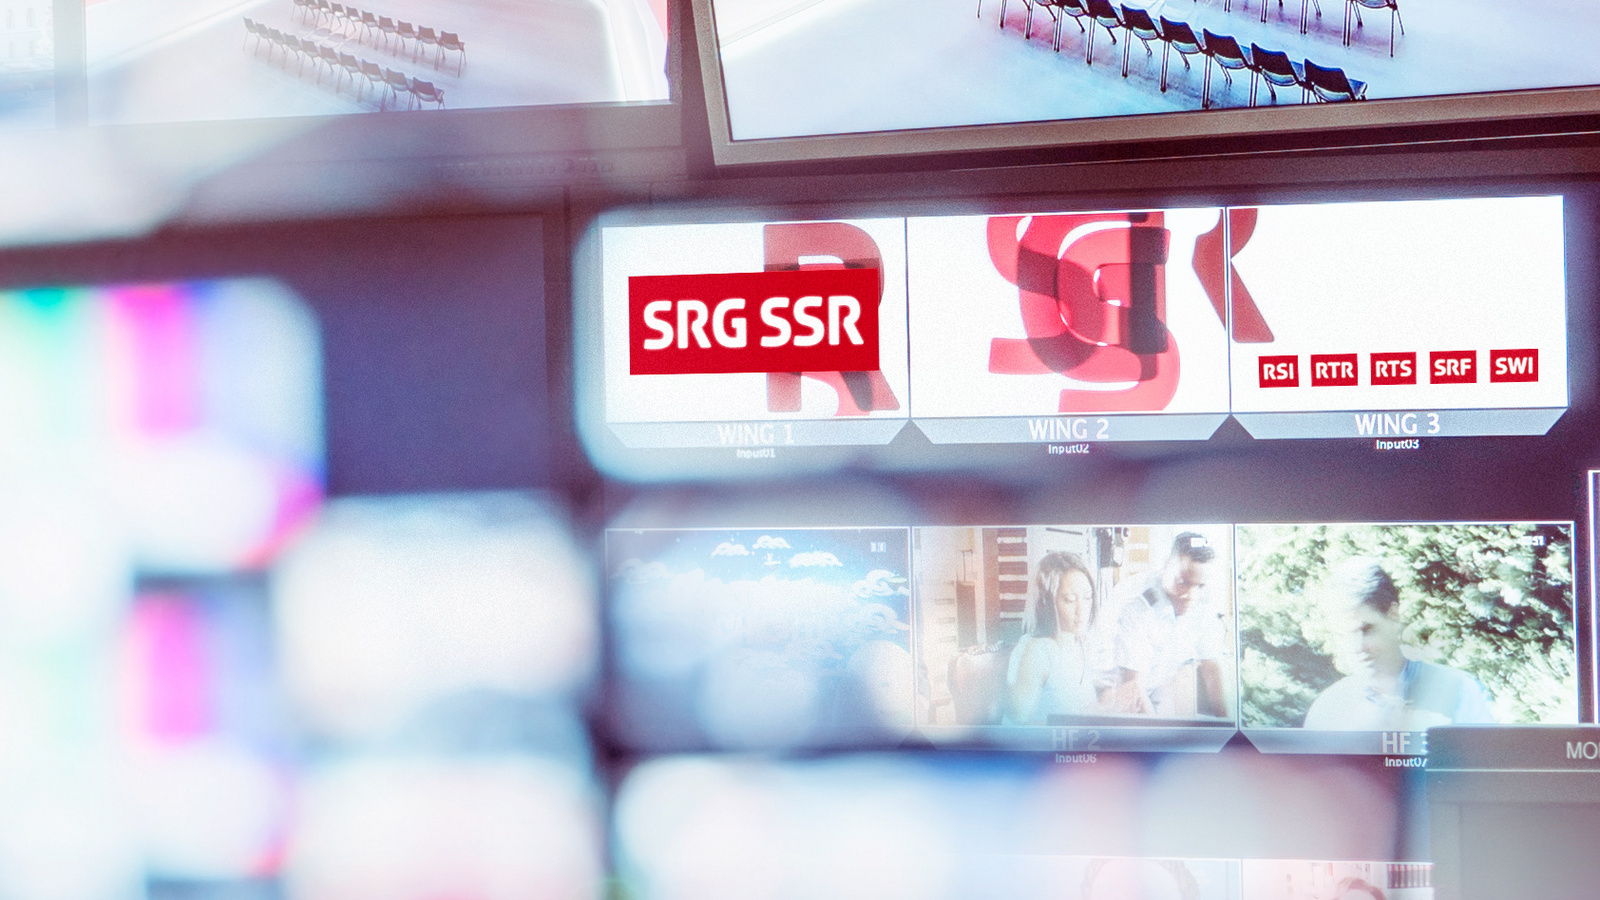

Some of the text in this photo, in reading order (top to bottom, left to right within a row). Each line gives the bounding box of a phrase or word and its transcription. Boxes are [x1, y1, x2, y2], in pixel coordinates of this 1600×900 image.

[642, 295, 865, 351] SRG SSR
[1263, 356, 1534, 380] RSI RTR RTS SRF SWI
[717, 423, 795, 445] WING 1
[1027, 418, 1110, 441] WING 2
[1354, 411, 1441, 436] WING 3
[1047, 443, 1090, 455] Input02
[1375, 438, 1420, 451] Input03
[1051, 728, 1100, 752] HF 2
[1382, 731, 1411, 754] HF
[1566, 741, 1600, 760] MO
